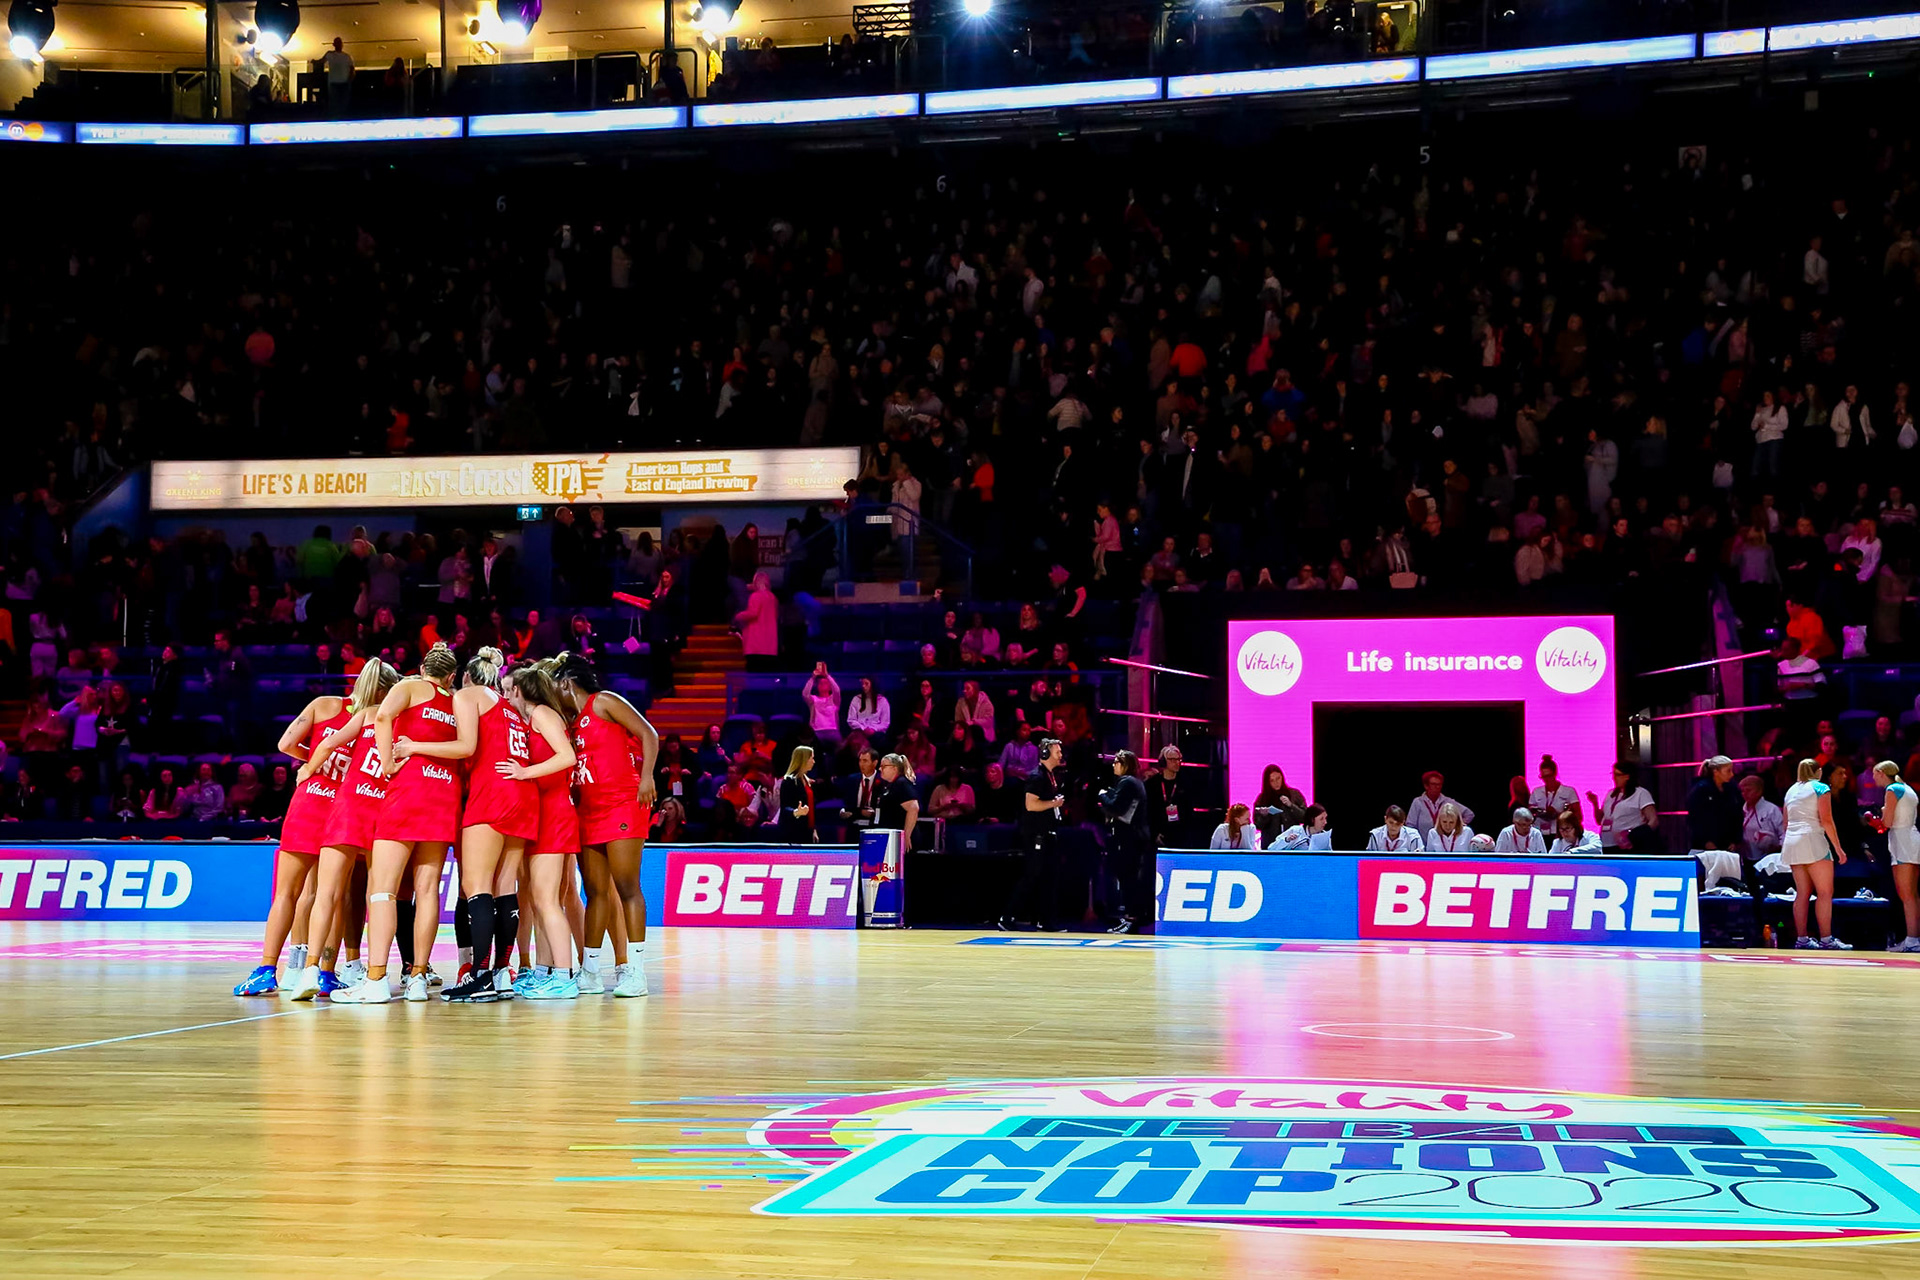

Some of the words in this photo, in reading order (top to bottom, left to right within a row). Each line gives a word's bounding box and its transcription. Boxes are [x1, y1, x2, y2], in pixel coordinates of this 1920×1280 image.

[1420, 146, 1430, 164] 5
[937, 175, 946, 192] 6
[496, 195, 506, 212] 6
[399, 471, 449, 497] EAST
[458, 462, 530, 496] Coast
[547, 463, 584, 494] IPA
[632, 463, 678, 476] American
[680, 462, 704, 477] Hops
[706, 460, 724, 473] and
[243, 474, 293, 494] LIFE'S
[298, 474, 309, 494] A
[314, 473, 367, 494] BEACH
[631, 478, 651, 491] East
[653, 477, 663, 491] of
[665, 476, 703, 493] England
[705, 476, 749, 491] Brewing
[1244, 650, 1295, 674] Vitality
[1347, 650, 1393, 672] Life
[1404, 651, 1523, 672] insurance
[1543, 647, 1598, 673] Vitality
[422, 707, 457, 728] CARDWE
[360, 747, 388, 782] G
[422, 764, 452, 784] Vitality
[676, 863, 857, 916] BETF
[1079, 1088, 1573, 1120] Vitality
[1006, 1117, 1746, 1146] NETBALL
[926, 1138, 1837, 1181] NATIONS
[875, 1168, 1336, 1206] CUP
[1338, 1172, 1880, 1217] 2020
